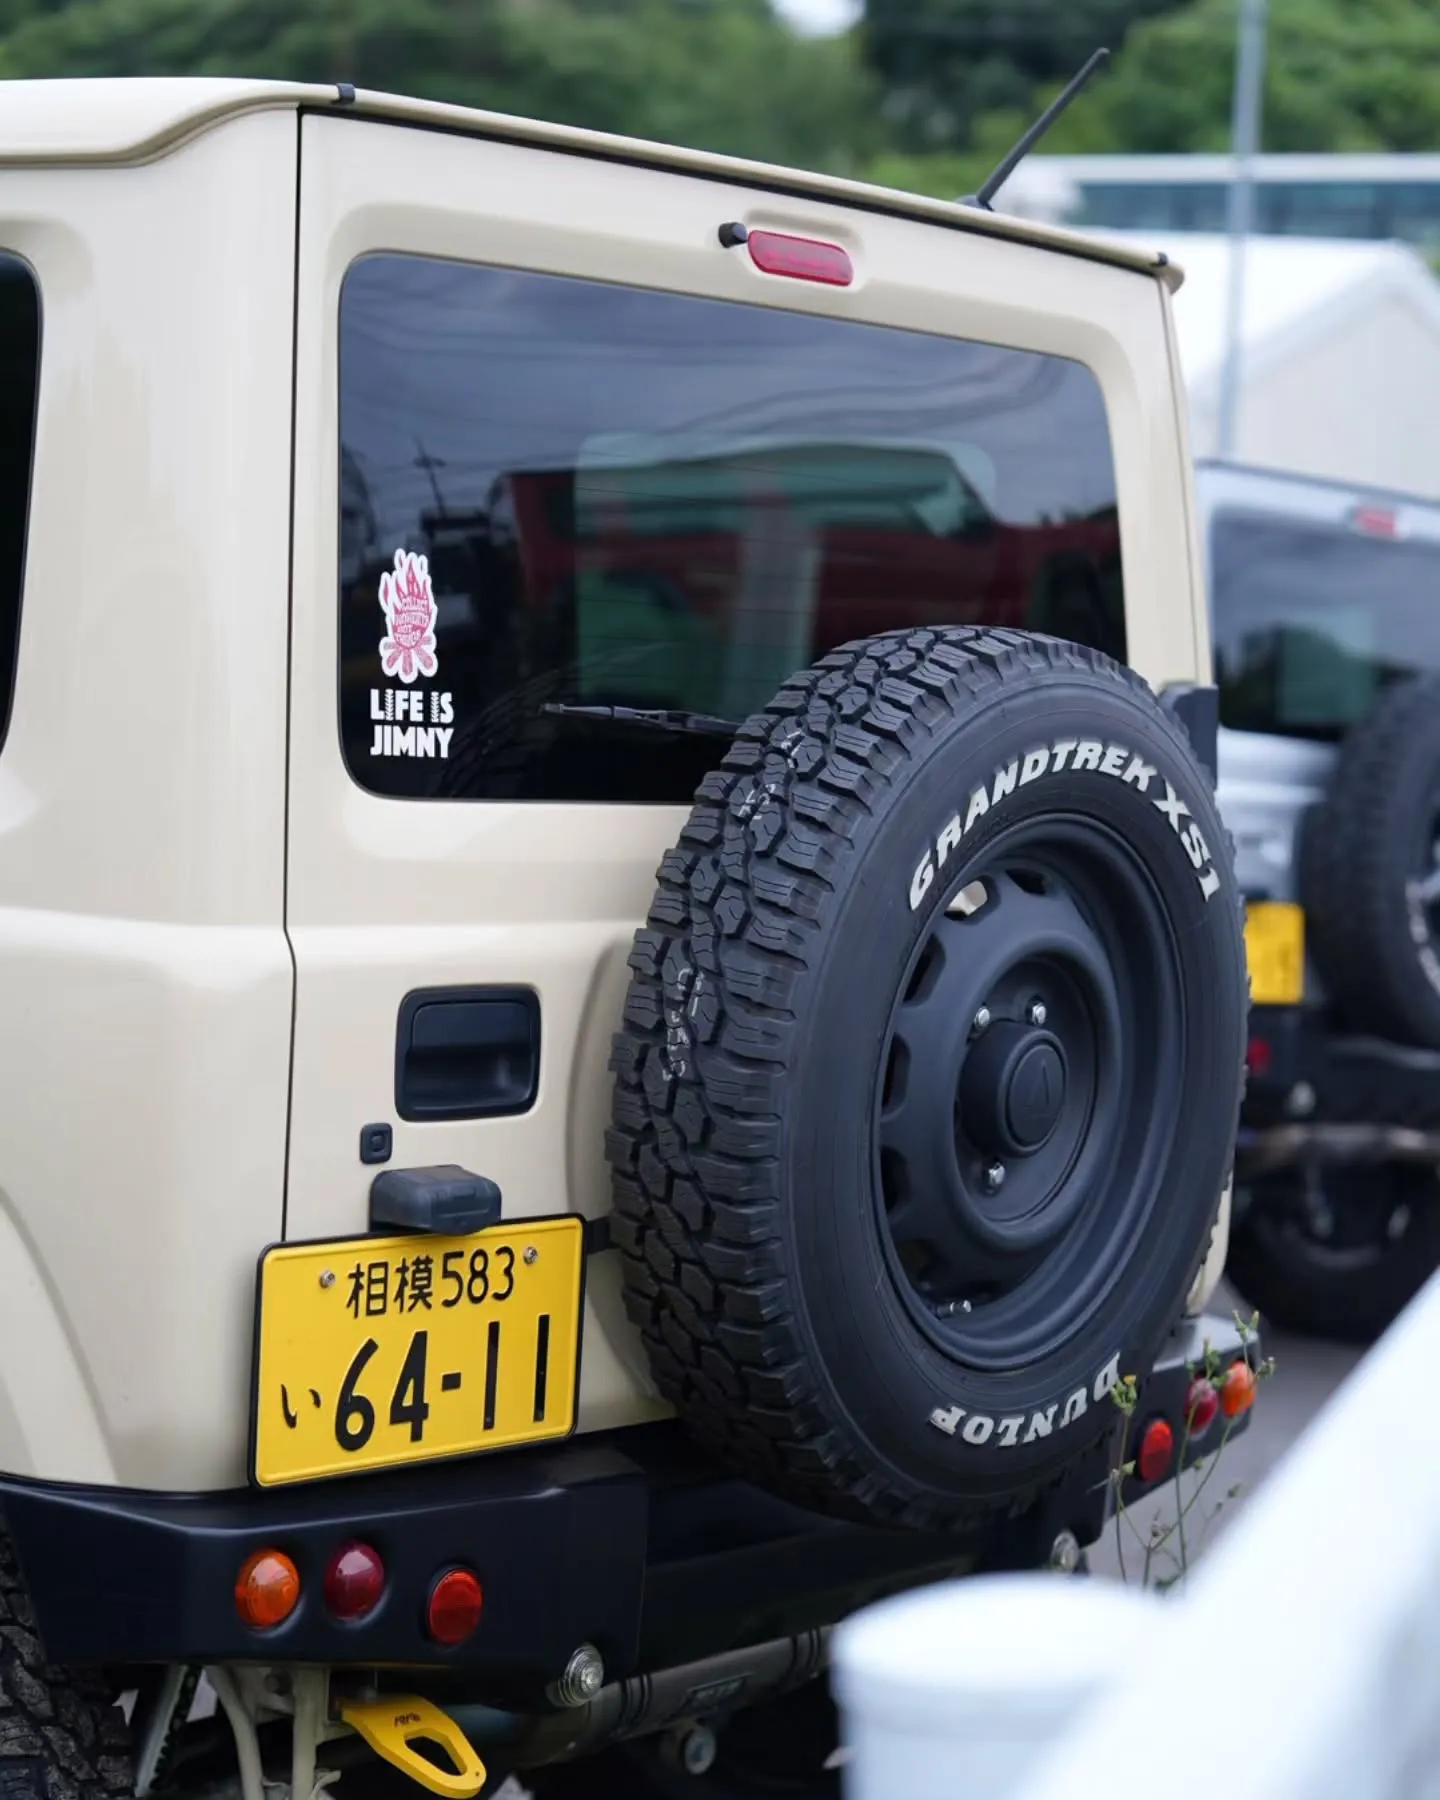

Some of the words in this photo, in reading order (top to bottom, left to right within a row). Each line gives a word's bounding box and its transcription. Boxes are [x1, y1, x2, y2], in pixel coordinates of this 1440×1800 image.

[370, 688, 424, 722] LIFE
[430, 691, 455, 724] IS
[370, 725, 455, 758] JIMNY
[909, 737, 1158, 912] GRANDTREK
[1152, 775, 1221, 903] XS1
[929, 1351, 1121, 1448] DUNLOP
